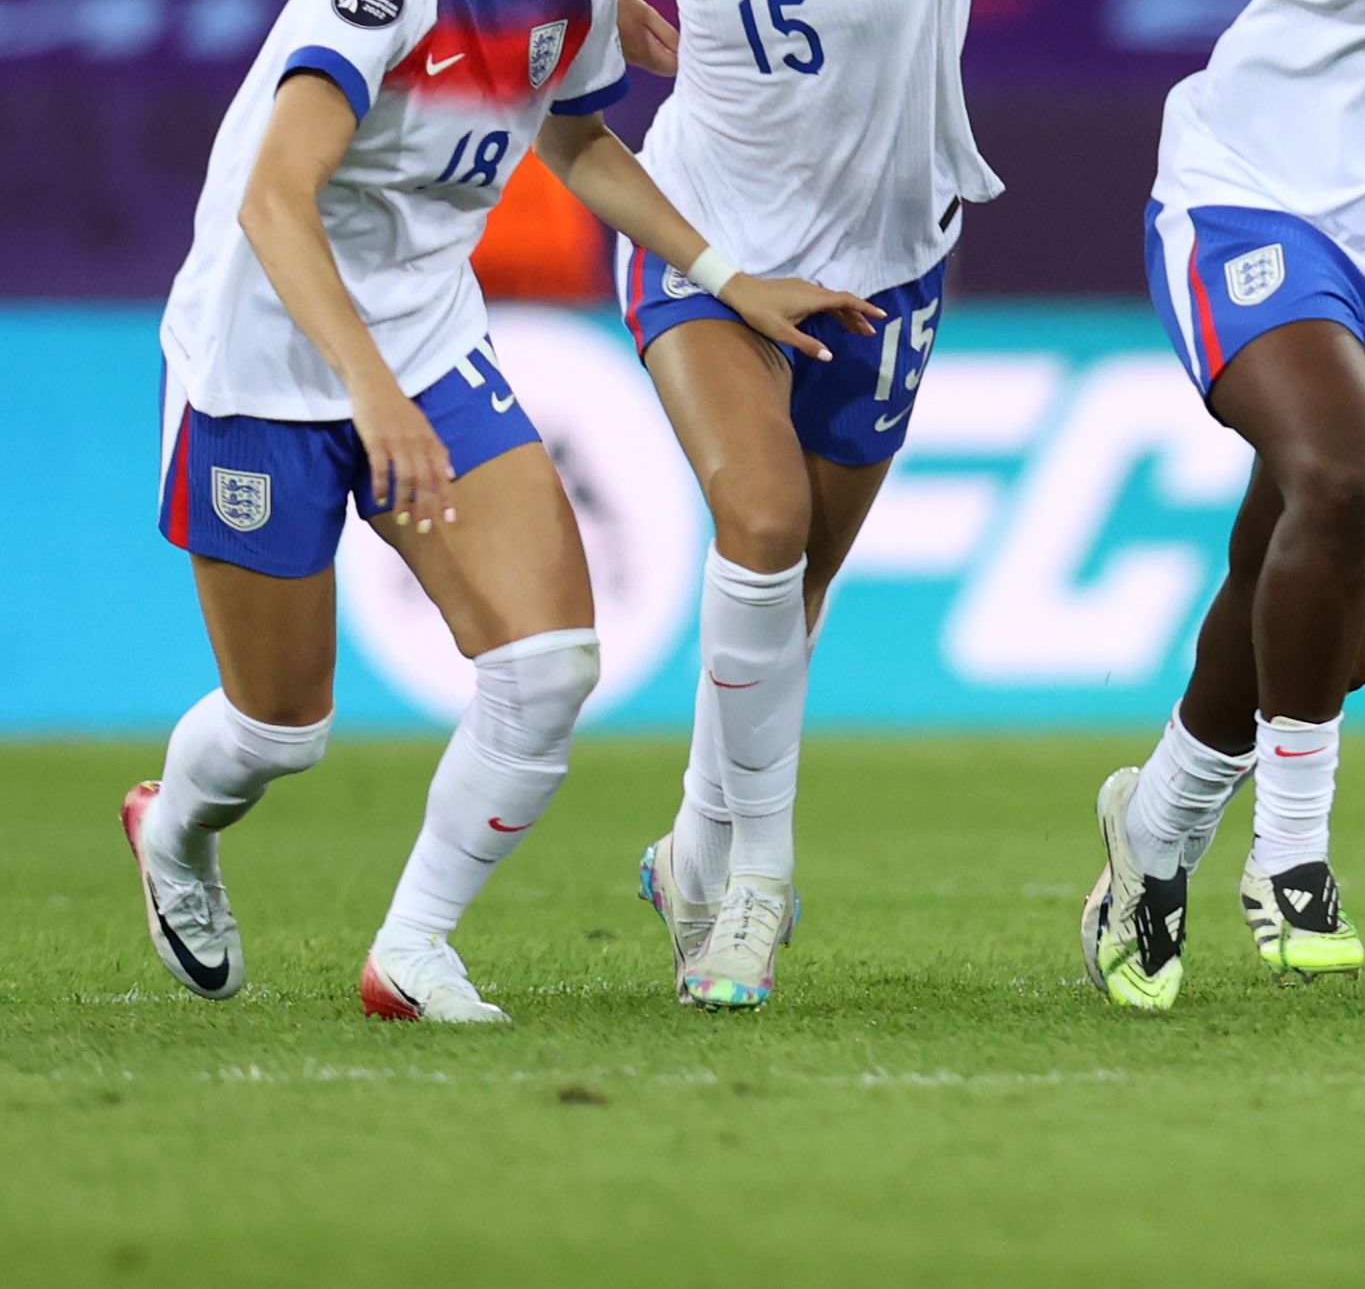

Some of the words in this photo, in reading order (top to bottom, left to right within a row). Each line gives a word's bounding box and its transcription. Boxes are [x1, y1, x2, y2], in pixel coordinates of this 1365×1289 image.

[362, 3, 387, 20] 2022
[434, 130, 511, 187] 18
[874, 297, 938, 401] 15
